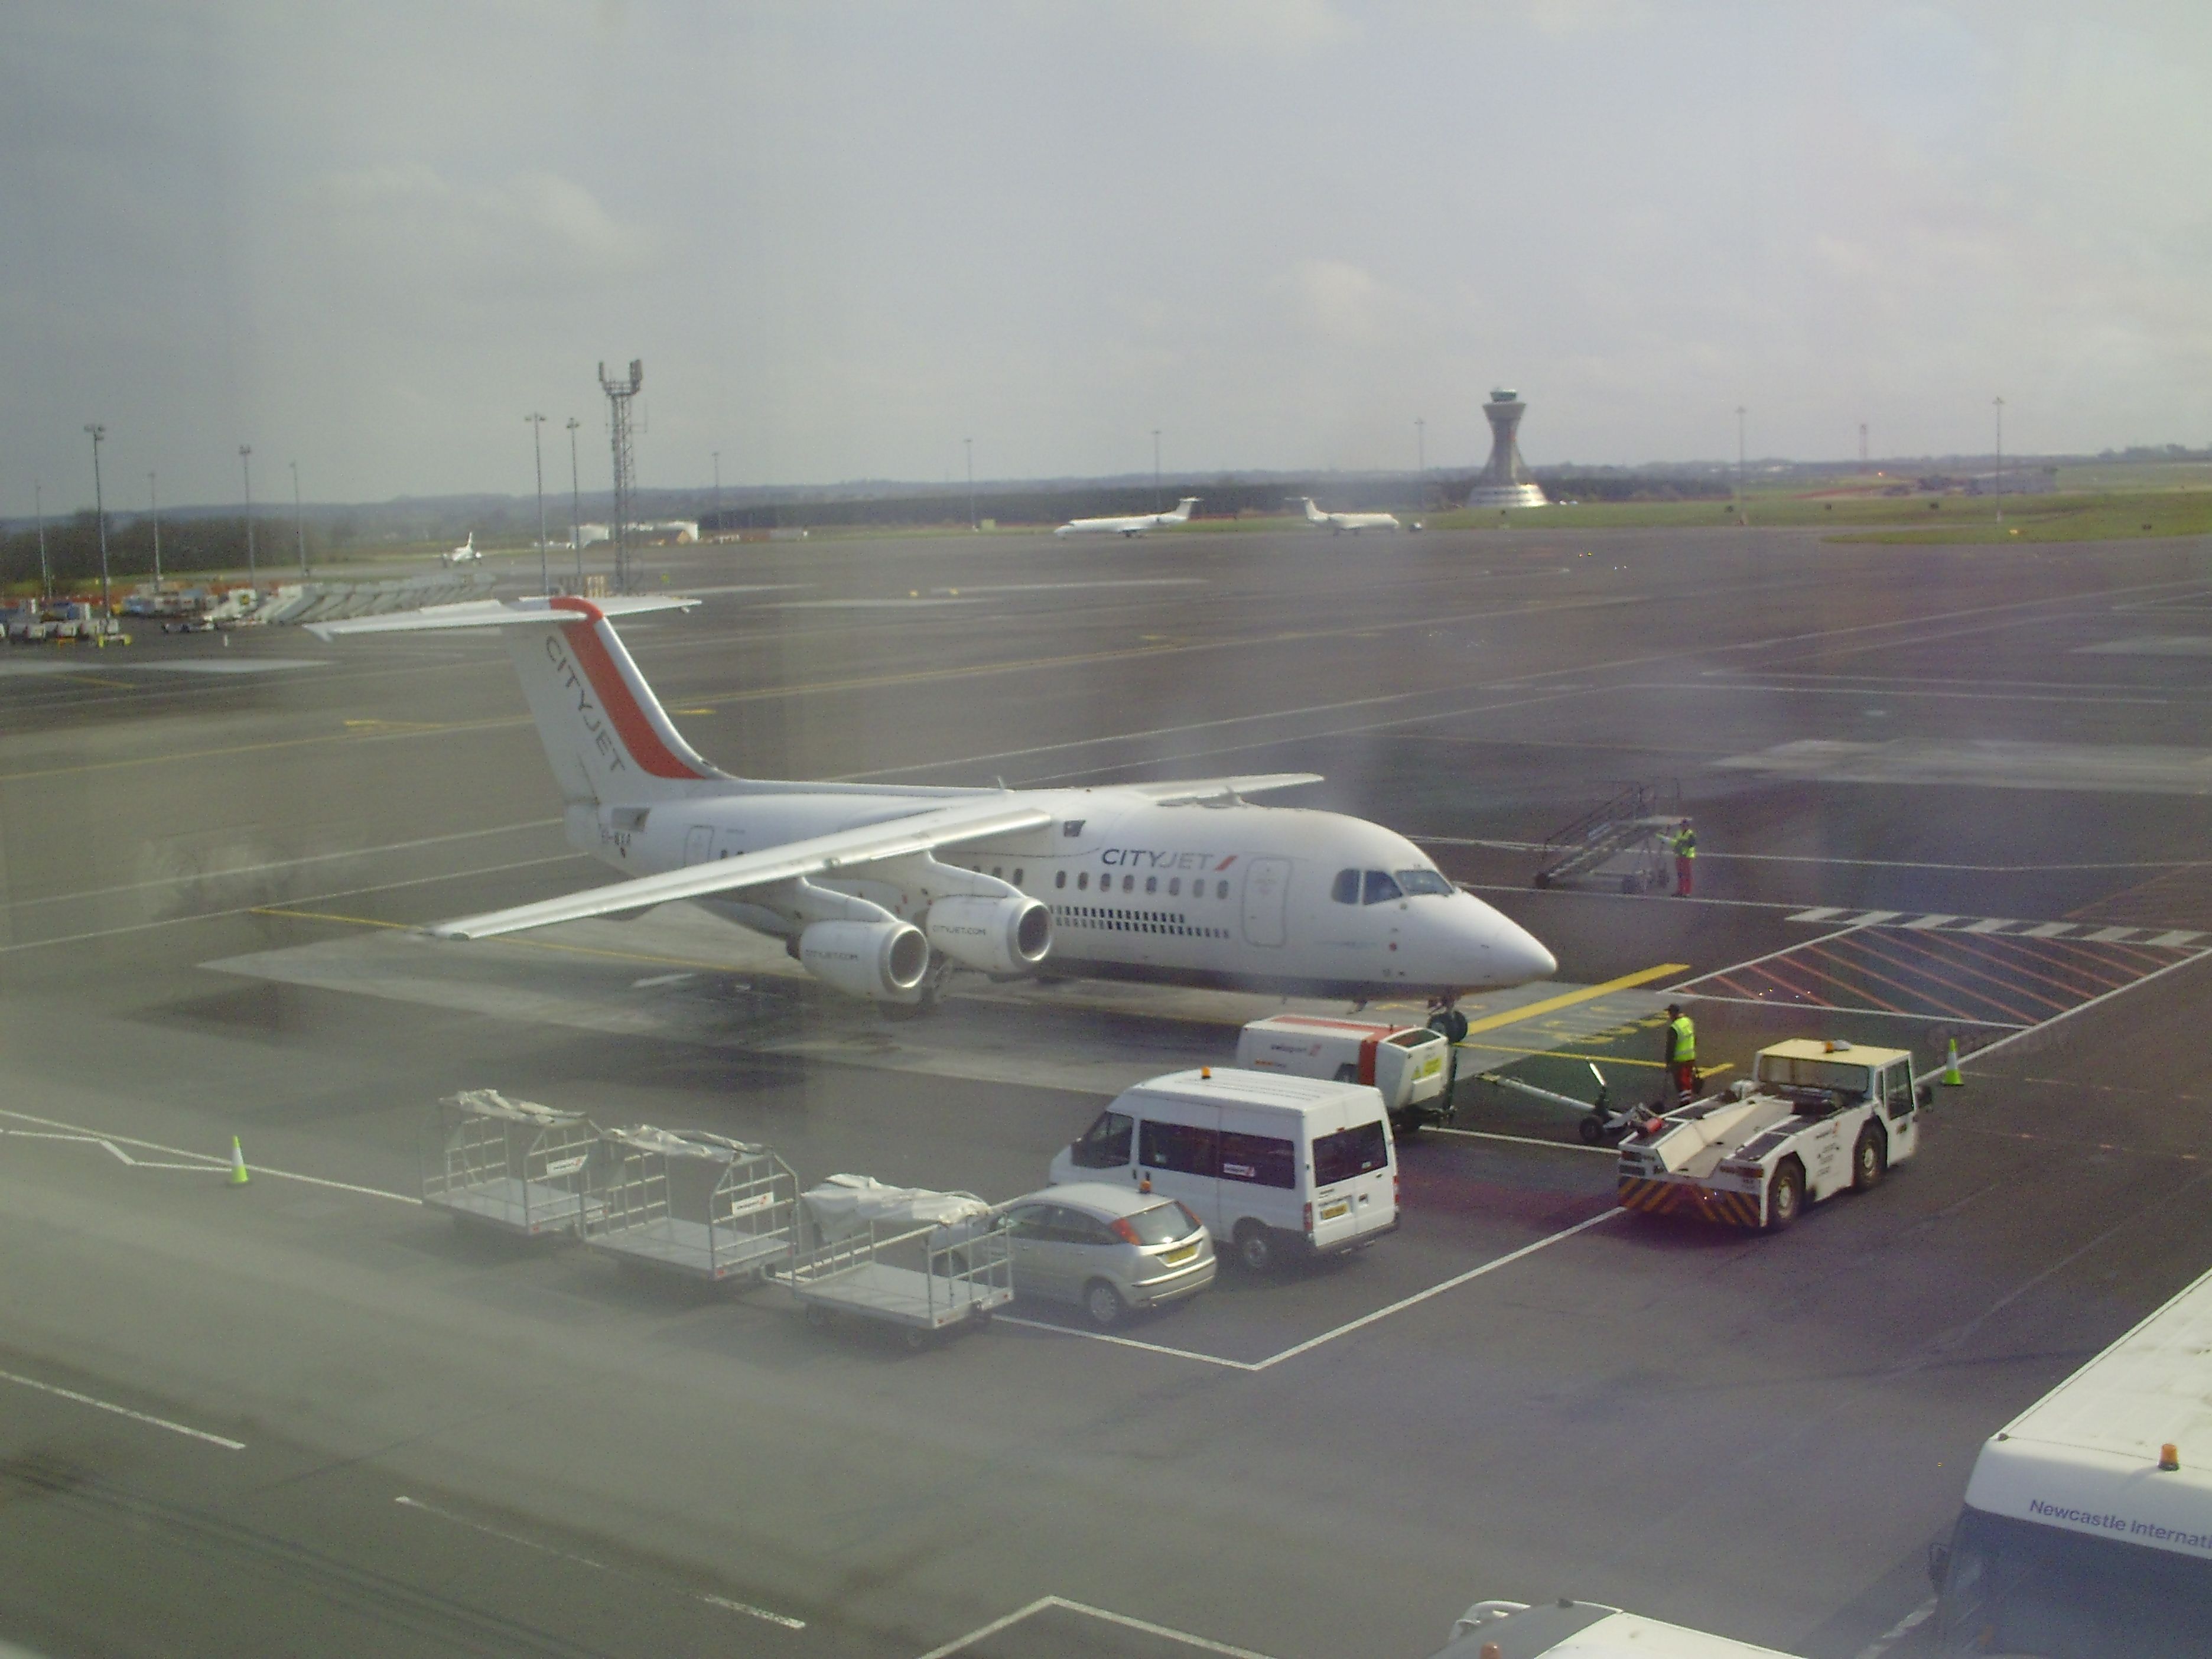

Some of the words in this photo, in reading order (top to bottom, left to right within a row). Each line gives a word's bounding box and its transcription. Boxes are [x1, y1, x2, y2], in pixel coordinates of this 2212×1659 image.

[546, 636, 625, 770] CITYJET
[1102, 848, 1213, 870] CITYJET
[2029, 1499, 2126, 1531] Newcastle
